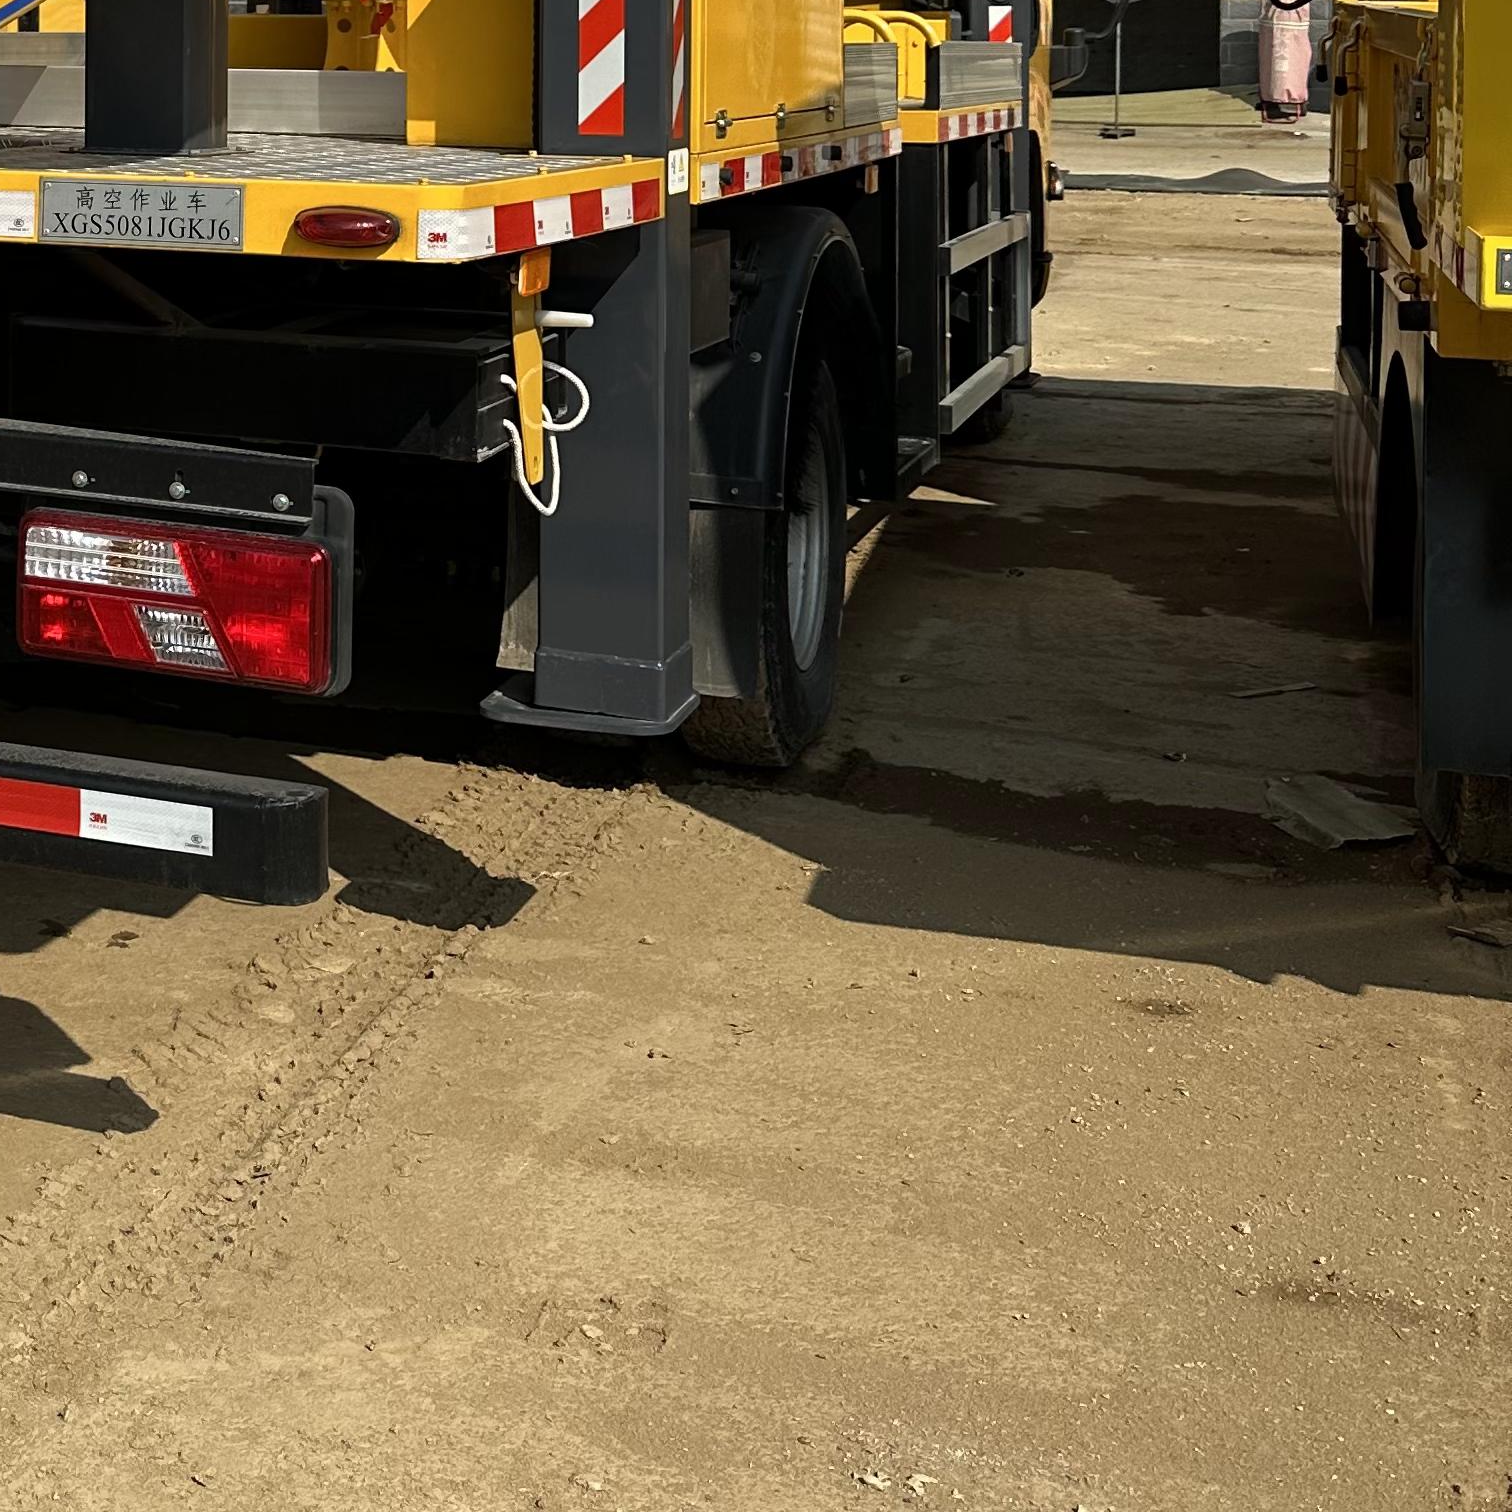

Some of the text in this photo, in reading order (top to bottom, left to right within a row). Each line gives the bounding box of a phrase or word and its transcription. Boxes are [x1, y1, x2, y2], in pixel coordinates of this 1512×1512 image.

[75, 186, 207, 214] 高空作业车
[52, 212, 231, 241] XGS5081JGKJ6
[428, 233, 447, 243] 3M
[90, 813, 107, 824] 3M
